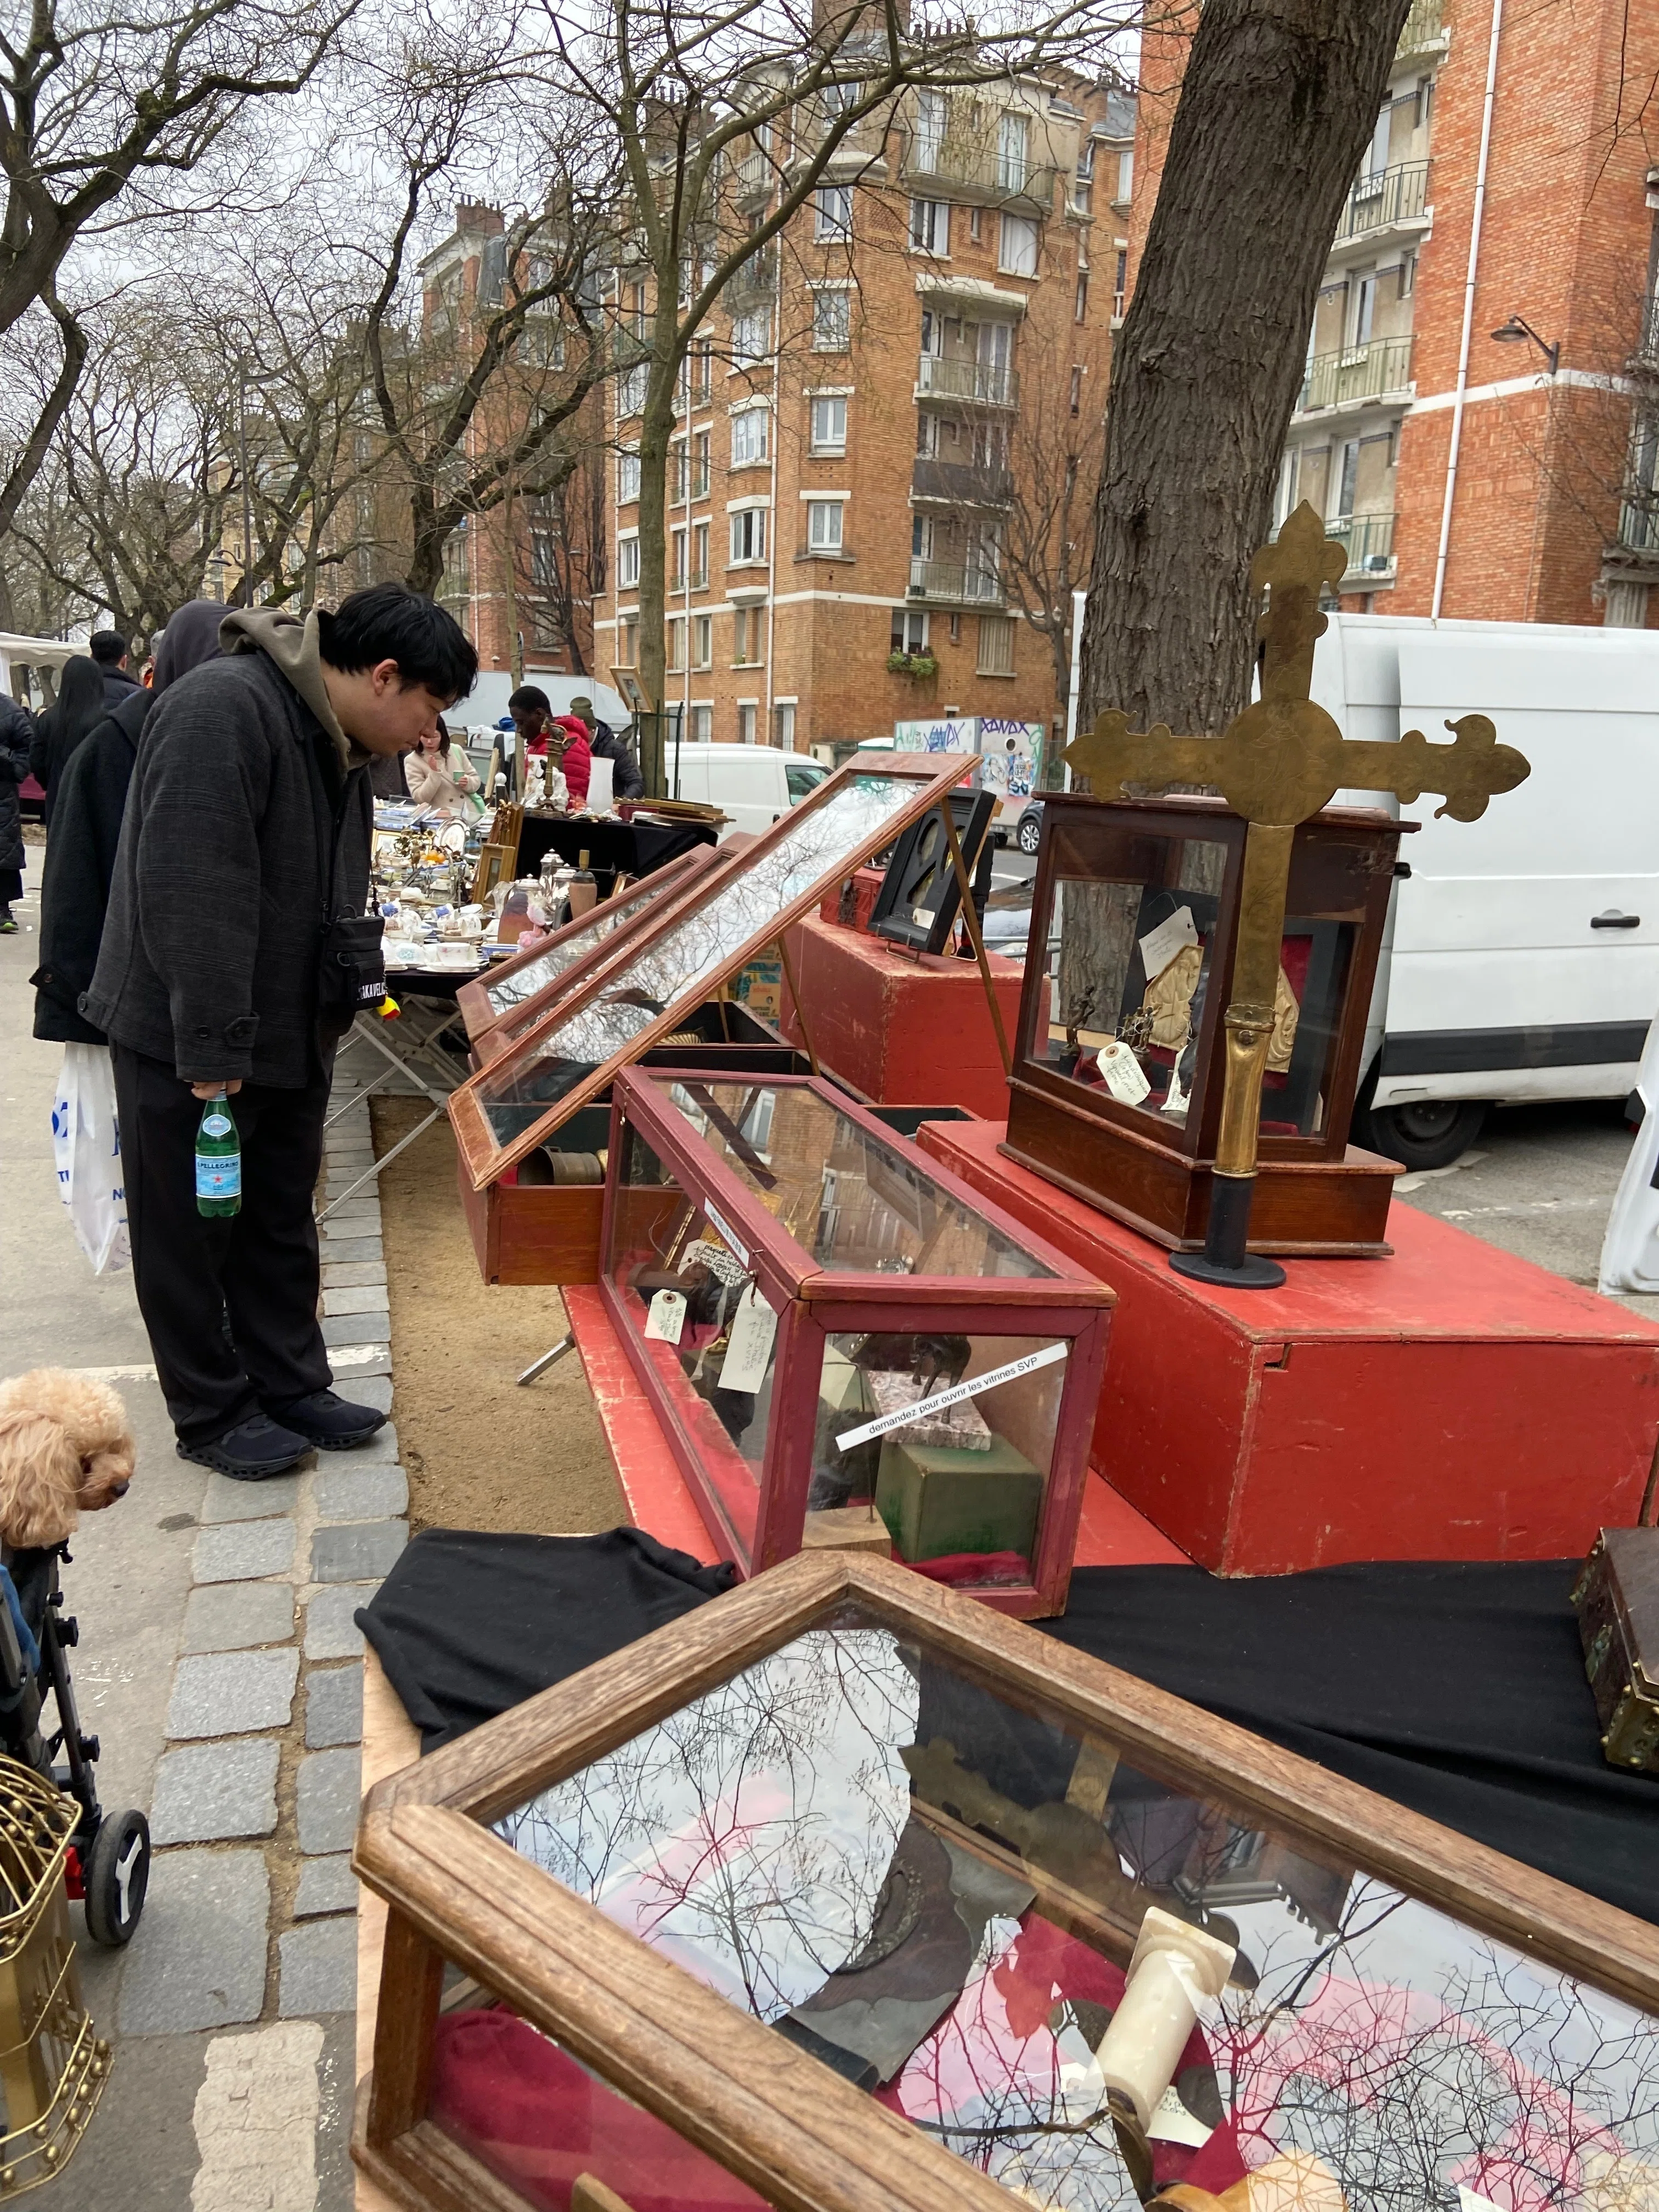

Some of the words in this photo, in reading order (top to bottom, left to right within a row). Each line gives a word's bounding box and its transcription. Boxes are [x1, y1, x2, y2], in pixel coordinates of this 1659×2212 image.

[868, 1408, 917, 1435] demandez
[918, 1398, 939, 1414] pour
[941, 1387, 966, 1404] ouvrir
[968, 1380, 982, 1394] les
[983, 1367, 1016, 1387] vitrines
[1017, 1356, 1038, 1372] SVP
